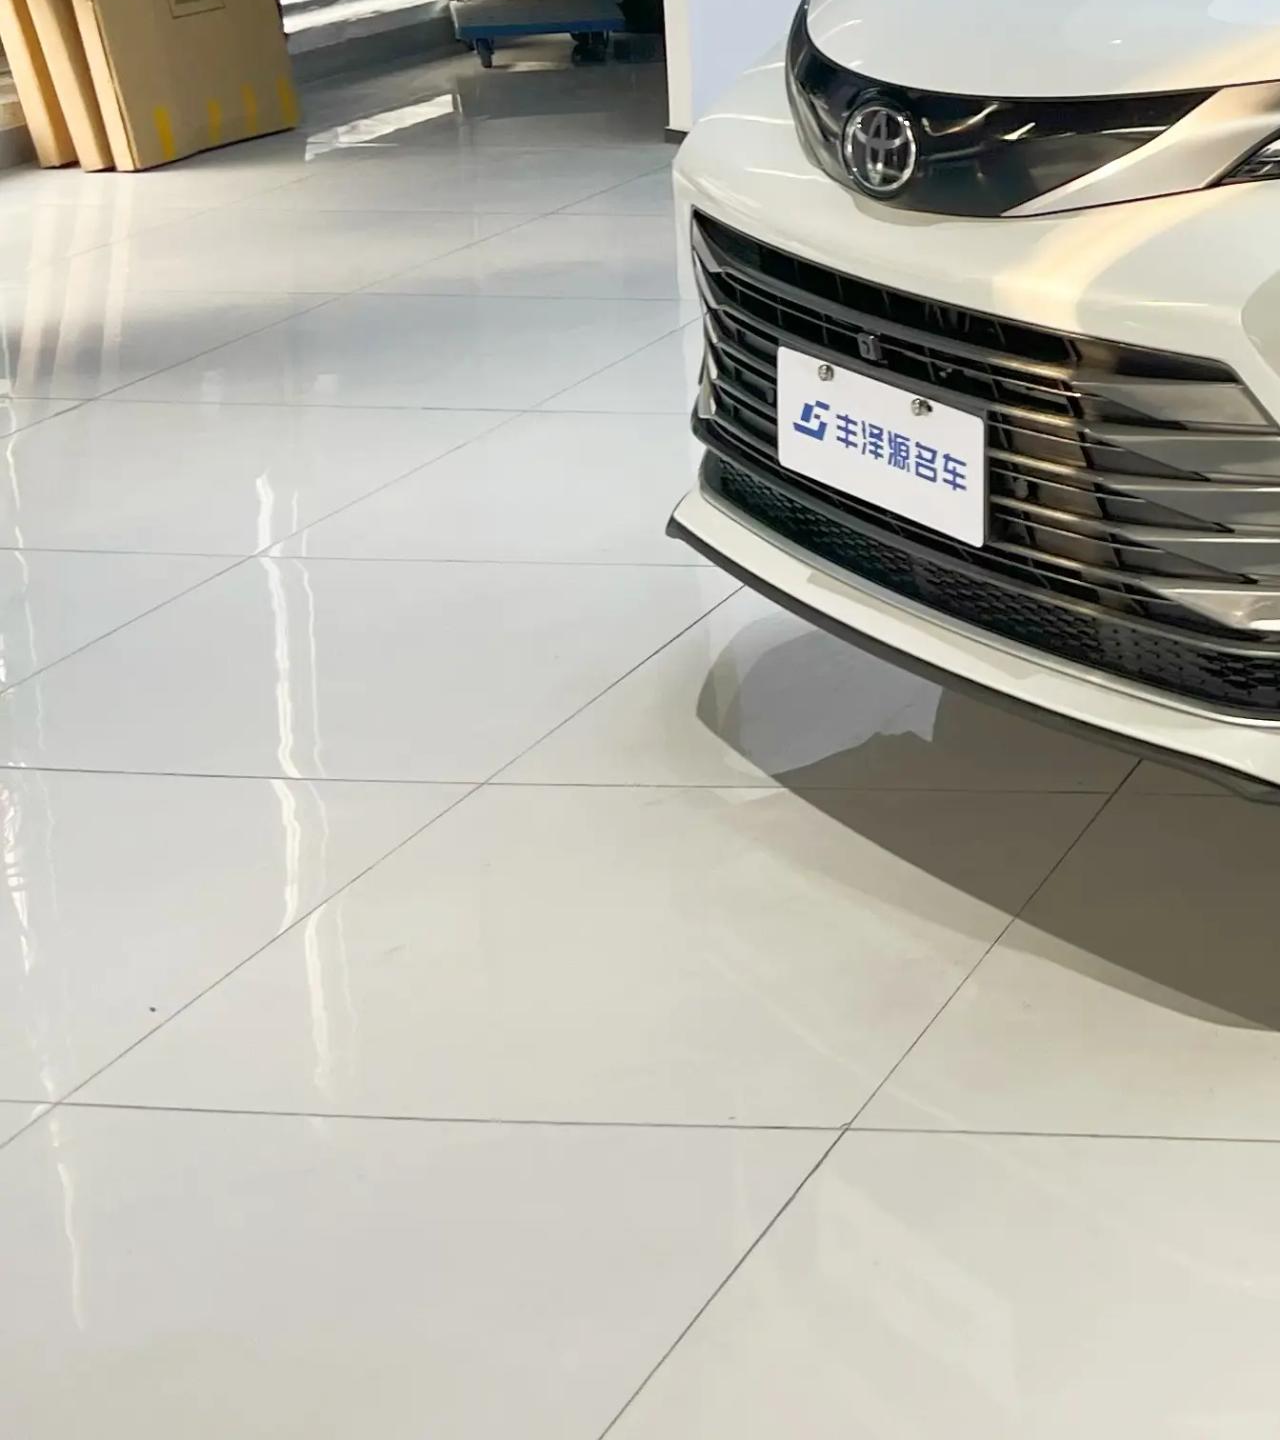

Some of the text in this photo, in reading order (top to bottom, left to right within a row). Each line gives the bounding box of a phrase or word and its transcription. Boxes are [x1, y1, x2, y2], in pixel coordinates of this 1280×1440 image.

[836, 414, 967, 491] 丰泽源名车
